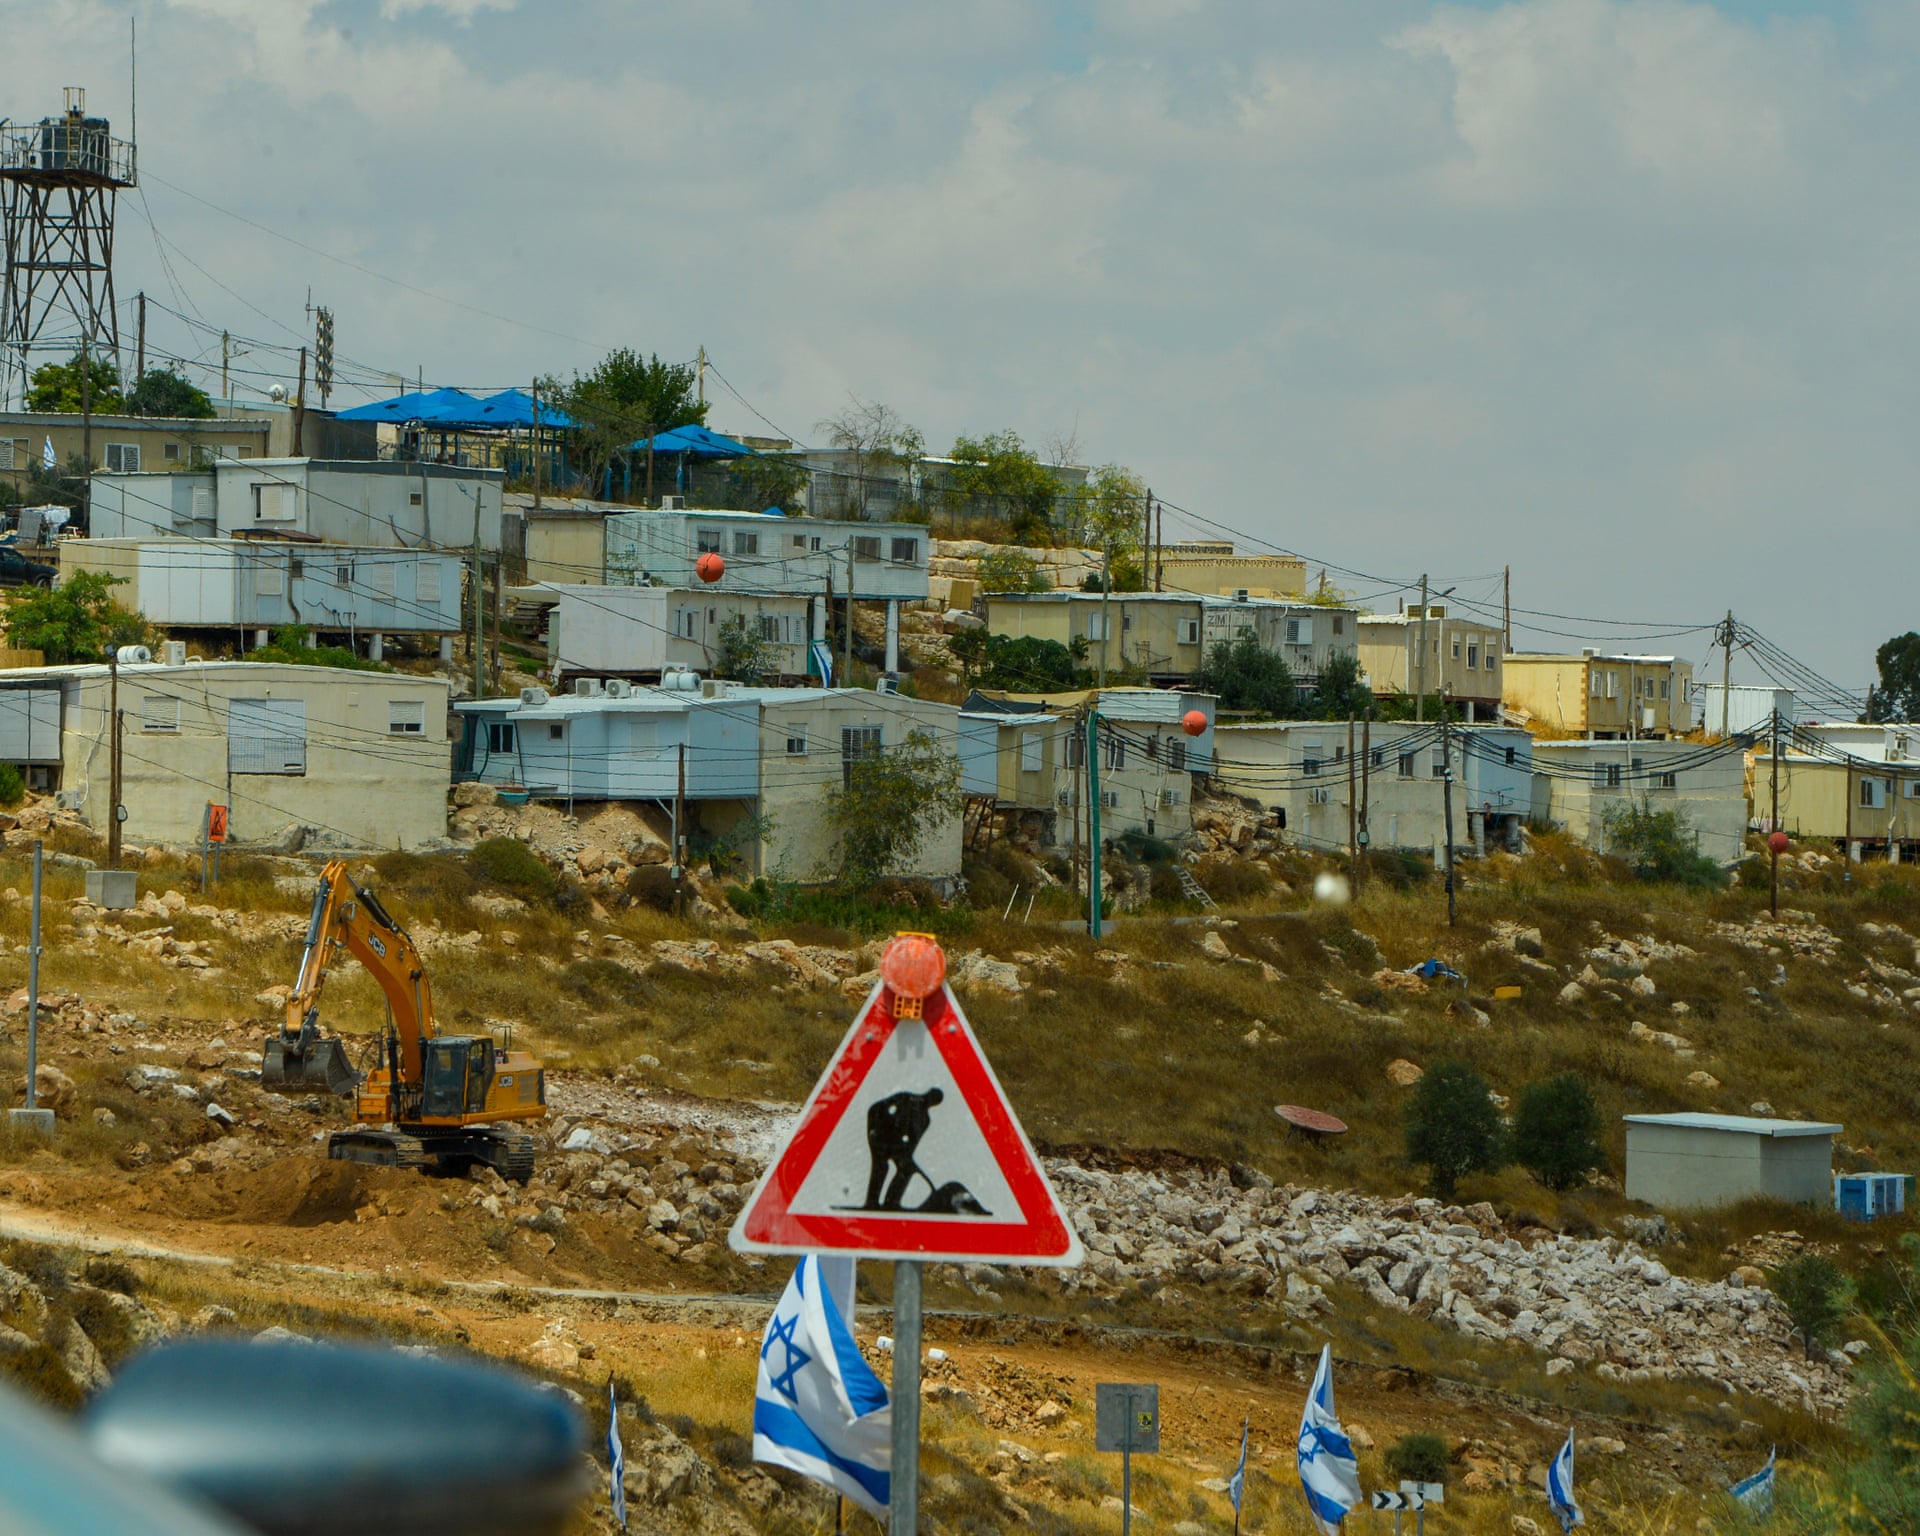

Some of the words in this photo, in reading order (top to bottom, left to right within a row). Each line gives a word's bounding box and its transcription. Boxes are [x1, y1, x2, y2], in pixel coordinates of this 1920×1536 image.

[1207, 614, 1226, 625] ZIM
[368, 933, 386, 958] JCB
[498, 1075, 513, 1088] JCB
